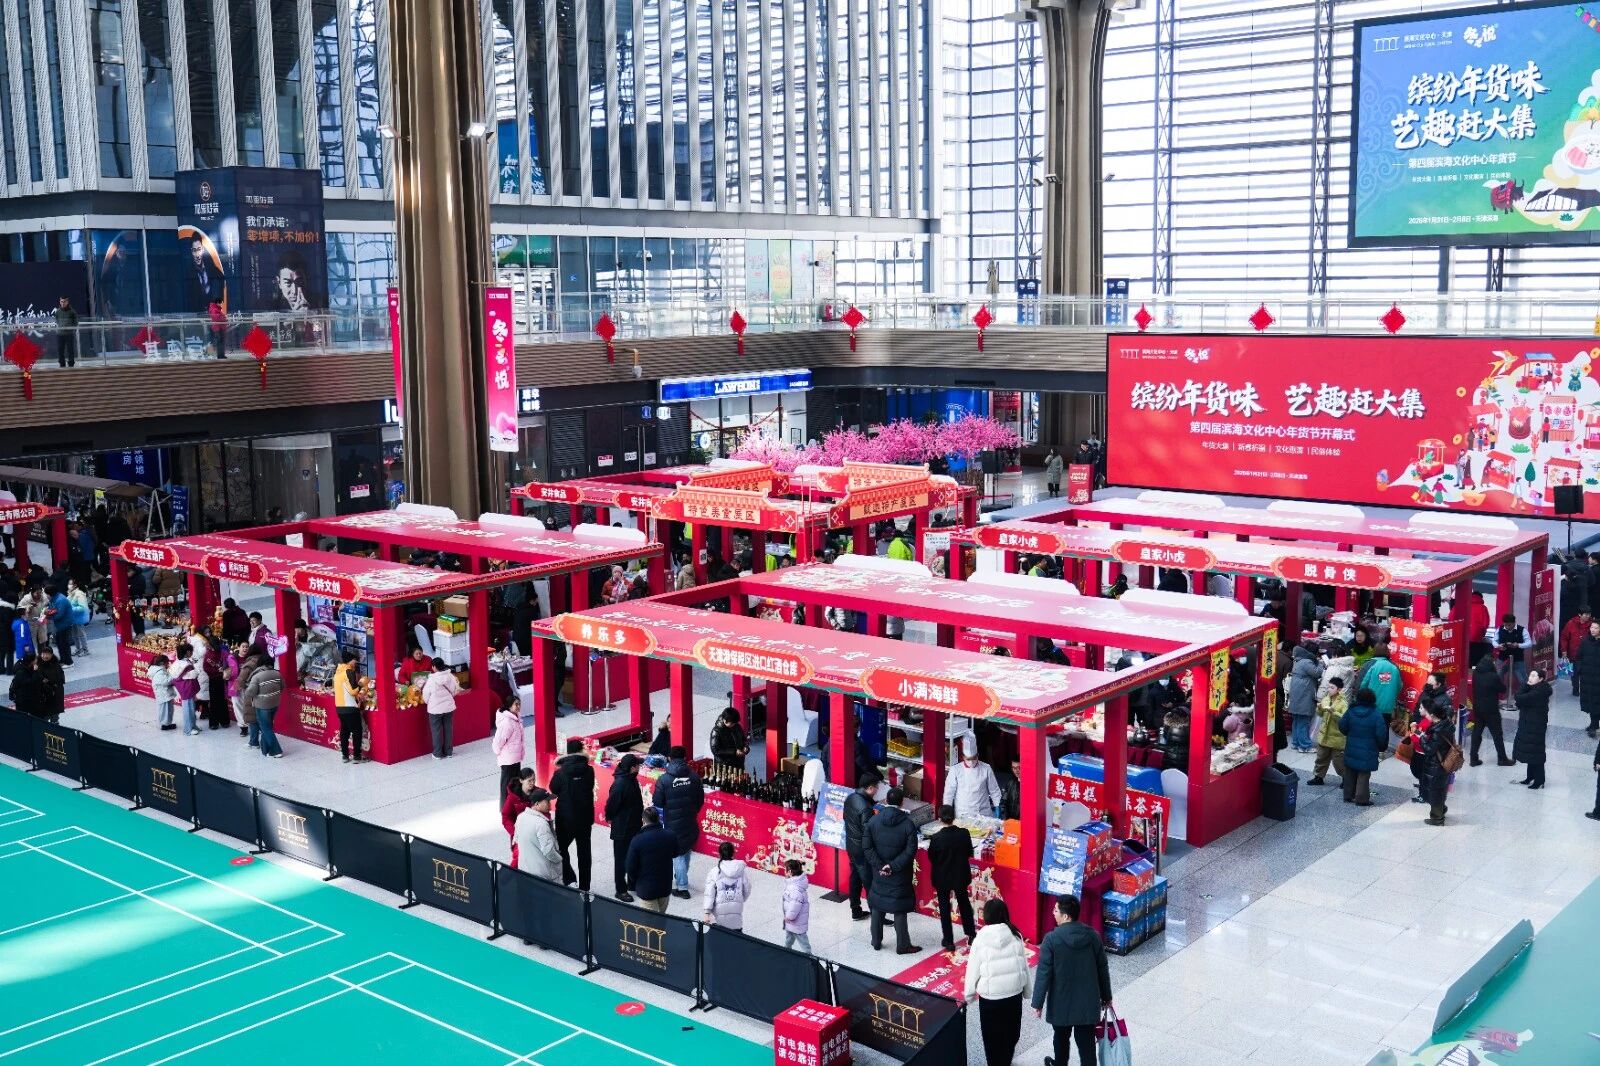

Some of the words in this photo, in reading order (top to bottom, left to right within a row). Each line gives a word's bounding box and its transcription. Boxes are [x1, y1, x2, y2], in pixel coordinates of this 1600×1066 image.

[1407, 60, 1550, 107] 缤纷年货味
[1391, 104, 1537, 151] 艺趣赶大集
[1408, 152, 1517, 169] 第四届滨海文化中心年货节
[1131, 378, 1266, 419] 缤纷年货味
[1285, 384, 1425, 419] 艺趣赶大集
[1190, 421, 1356, 441] 第四届滨海文化中心年货节开幕式
[540, 487, 567, 499] 安井食品
[688, 505, 755, 522] 特色美食展区
[998, 532, 1038, 548] 皇家小虎
[1140, 548, 1185, 563] 皇家小虎
[1304, 563, 1357, 582] 脱骨侠
[308, 576, 341, 594] 方特文创
[580, 623, 627, 645] 养乐多
[898, 678, 959, 706] 小满海鲜
[705, 808, 748, 829] 缤纷年货味
[701, 820, 745, 841] 艺趣赶大集
[777, 1034, 817, 1056] 有电危险
[777, 1046, 817, 1066] 请勿靠近
